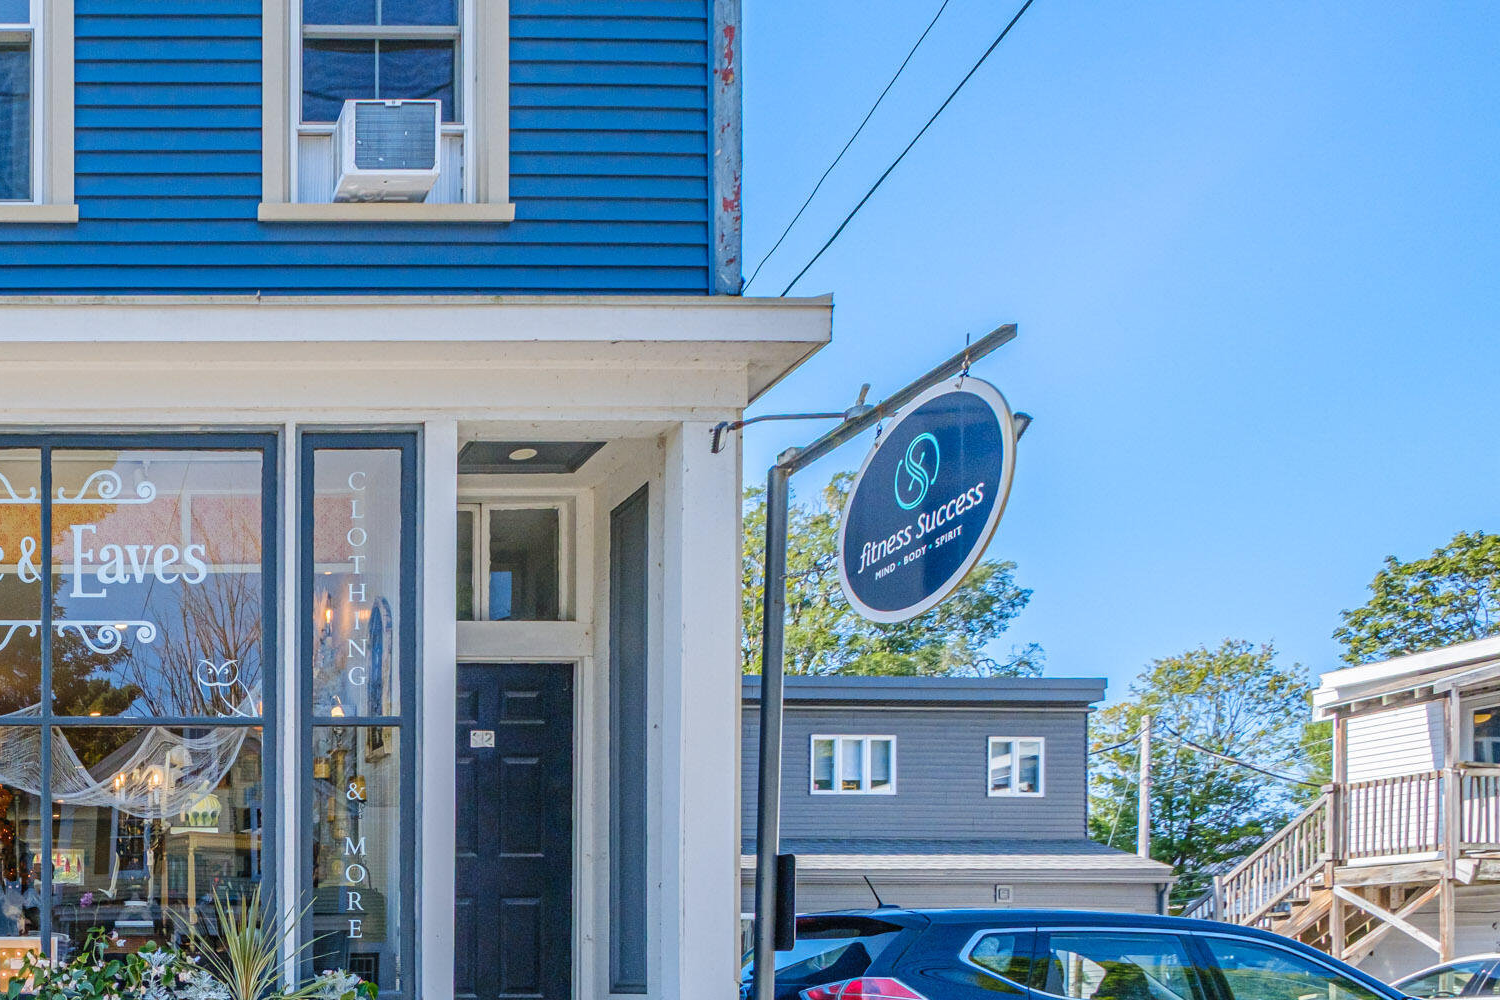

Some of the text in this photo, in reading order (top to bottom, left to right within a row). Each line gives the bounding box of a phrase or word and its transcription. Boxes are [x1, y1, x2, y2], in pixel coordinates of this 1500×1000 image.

[17, 536, 42, 584] &
[70, 524, 207, 598] Eaves
[346, 471, 368, 686] CLOTHING
[858, 525, 913, 574] fitness
[875, 525, 963, 580] MIND BODY SPIRIT
[346, 782, 366, 801] &
[344, 836, 367, 939] MORE
